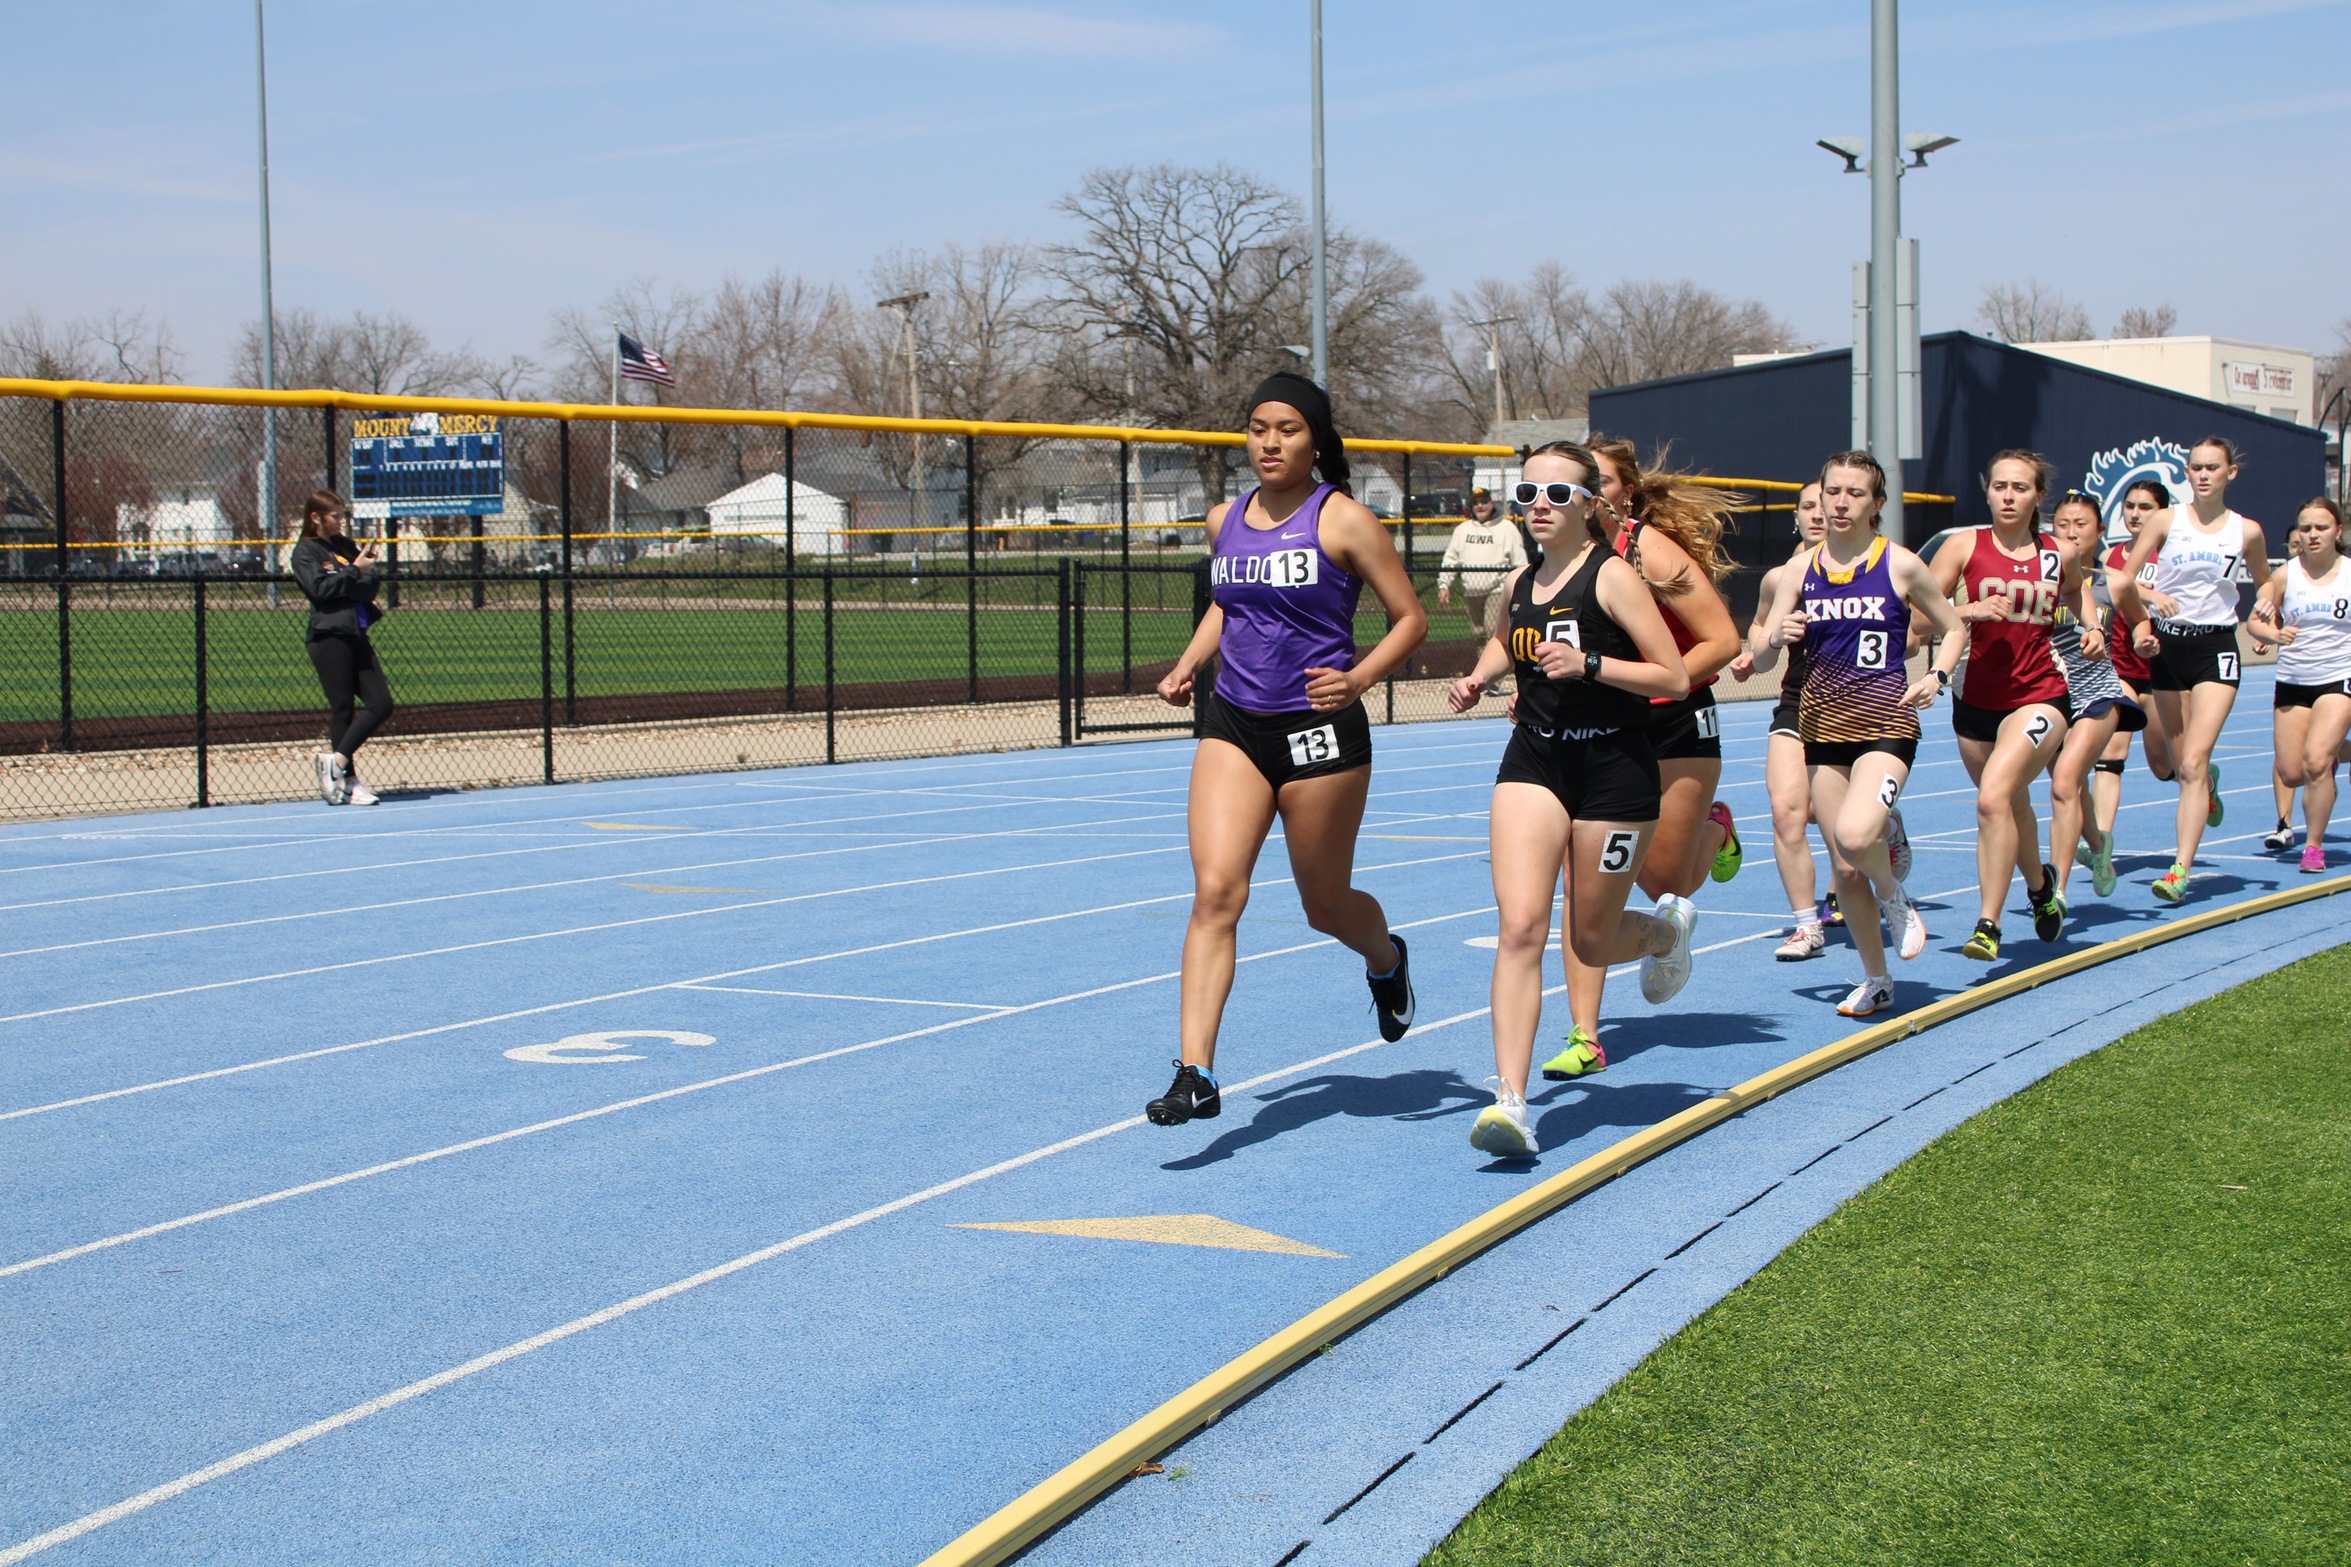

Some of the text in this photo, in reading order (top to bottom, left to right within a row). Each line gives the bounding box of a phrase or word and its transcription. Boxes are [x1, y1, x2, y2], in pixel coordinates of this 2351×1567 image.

[354, 415, 498, 438] MOUNT MERCY
[1465, 533, 1494, 544] IOWA
[1211, 556, 1276, 587] WALDO
[1278, 551, 1309, 584] 13
[2043, 552, 2059, 582] 2
[2223, 554, 2237, 579] 7
[1805, 596, 1886, 623] KNOX
[2333, 598, 2349, 619] 8
[1860, 633, 1883, 666] 3
[2221, 654, 2235, 678] 7
[1702, 708, 1720, 737] 11
[2026, 715, 2049, 745] 2
[1296, 729, 1330, 762] 13
[1880, 778, 1898, 809] 3
[1603, 833, 1633, 871] 5
